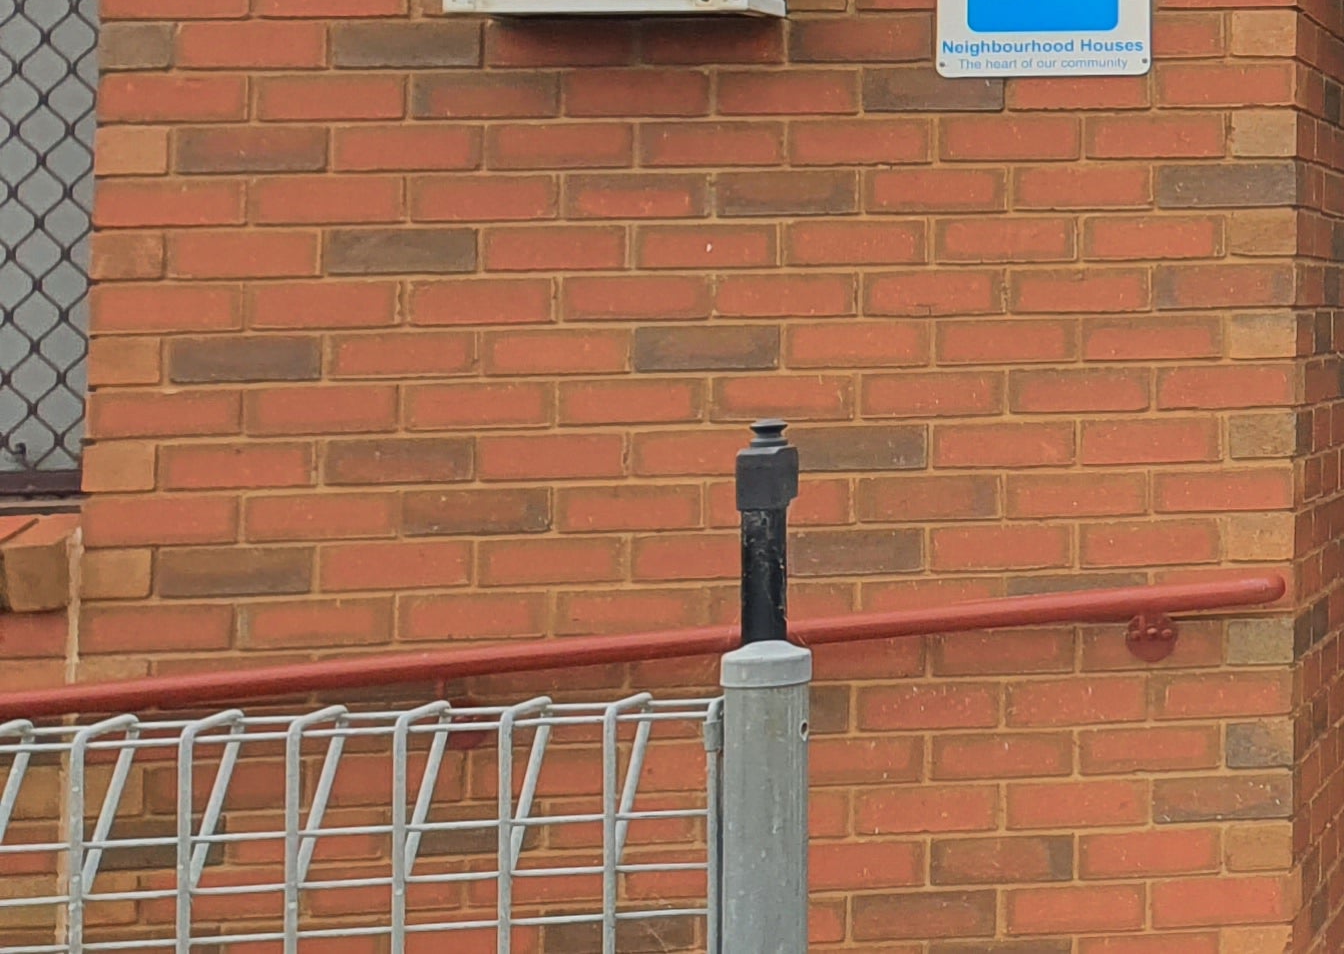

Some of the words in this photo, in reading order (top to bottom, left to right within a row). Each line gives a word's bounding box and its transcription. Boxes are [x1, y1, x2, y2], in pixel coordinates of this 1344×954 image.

[942, 39, 1074, 56] Neighbourhood
[1080, 38, 1144, 52] Houses
[959, 59, 982, 69] The
[985, 58, 1017, 69] heart
[1021, 58, 1033, 69] of
[1037, 60, 1056, 69] our
[1061, 58, 1129, 70] community
